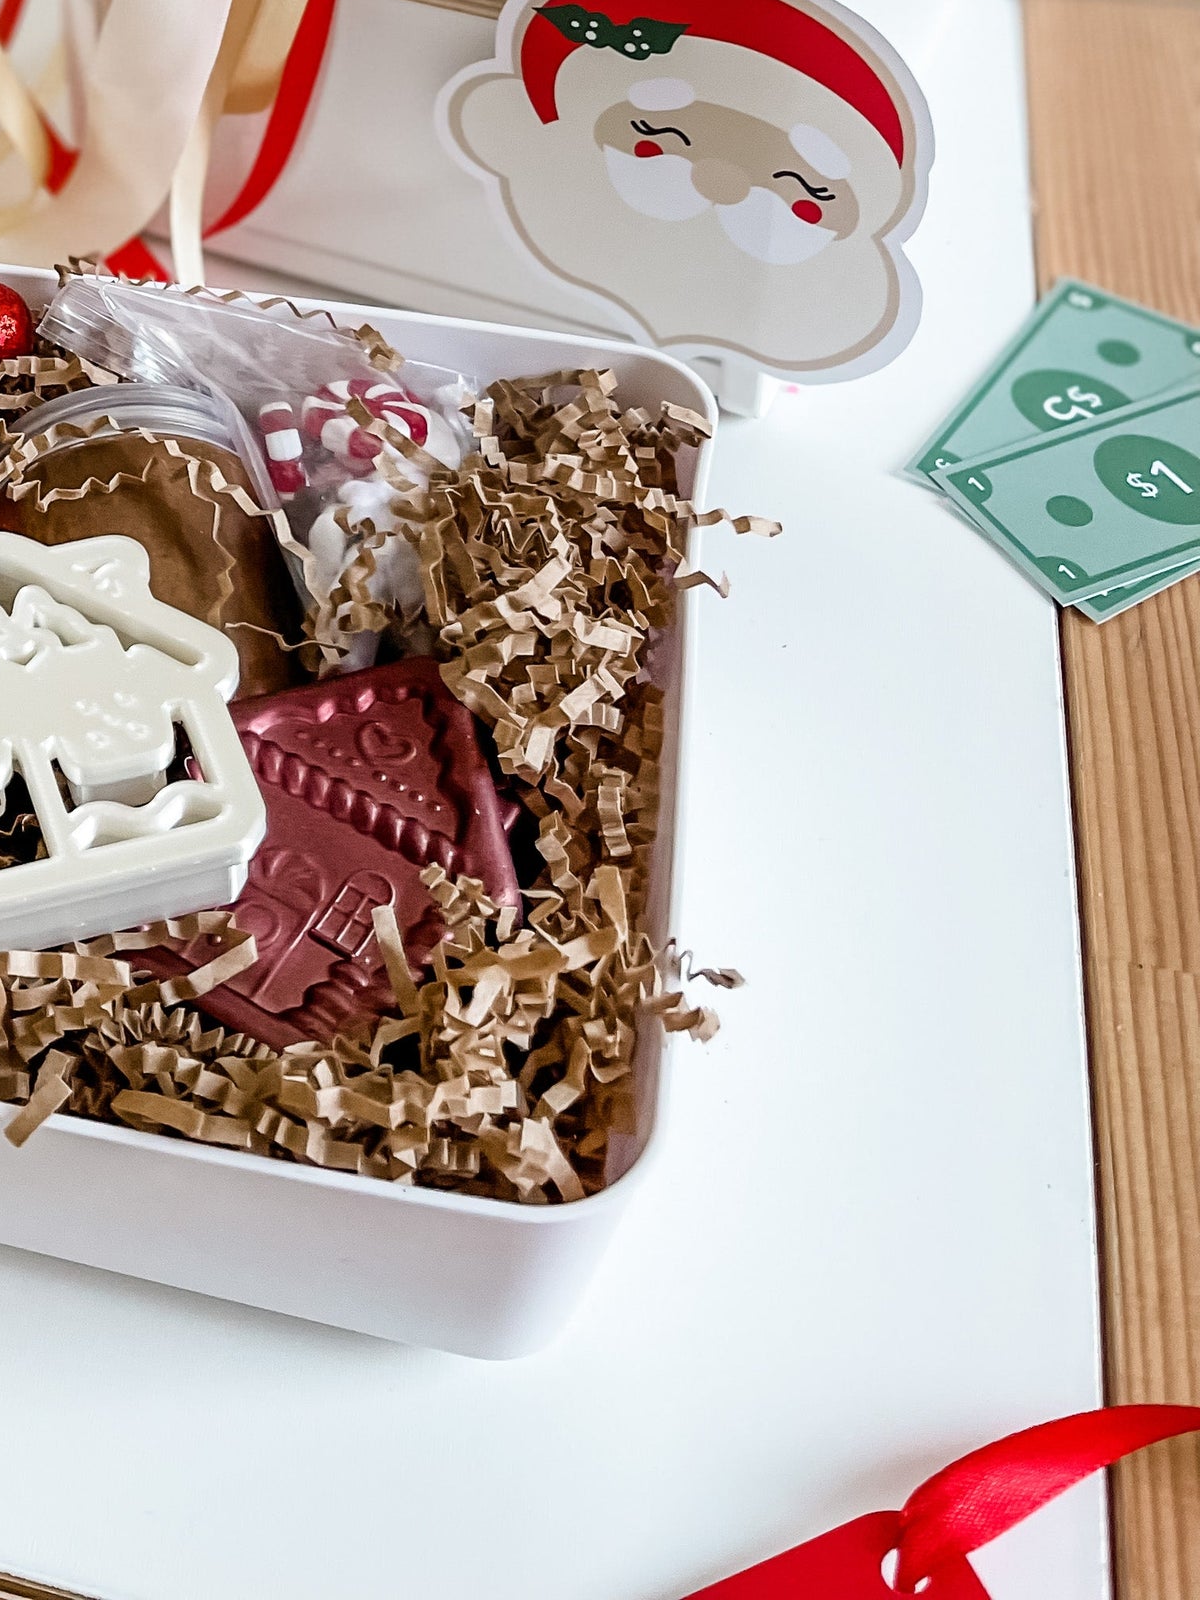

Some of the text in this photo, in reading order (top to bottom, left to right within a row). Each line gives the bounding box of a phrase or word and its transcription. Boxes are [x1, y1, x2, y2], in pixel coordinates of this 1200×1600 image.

[967, 477, 986, 491] 1
[1126, 460, 1194, 498] $1
[1058, 564, 1077, 579] 1
